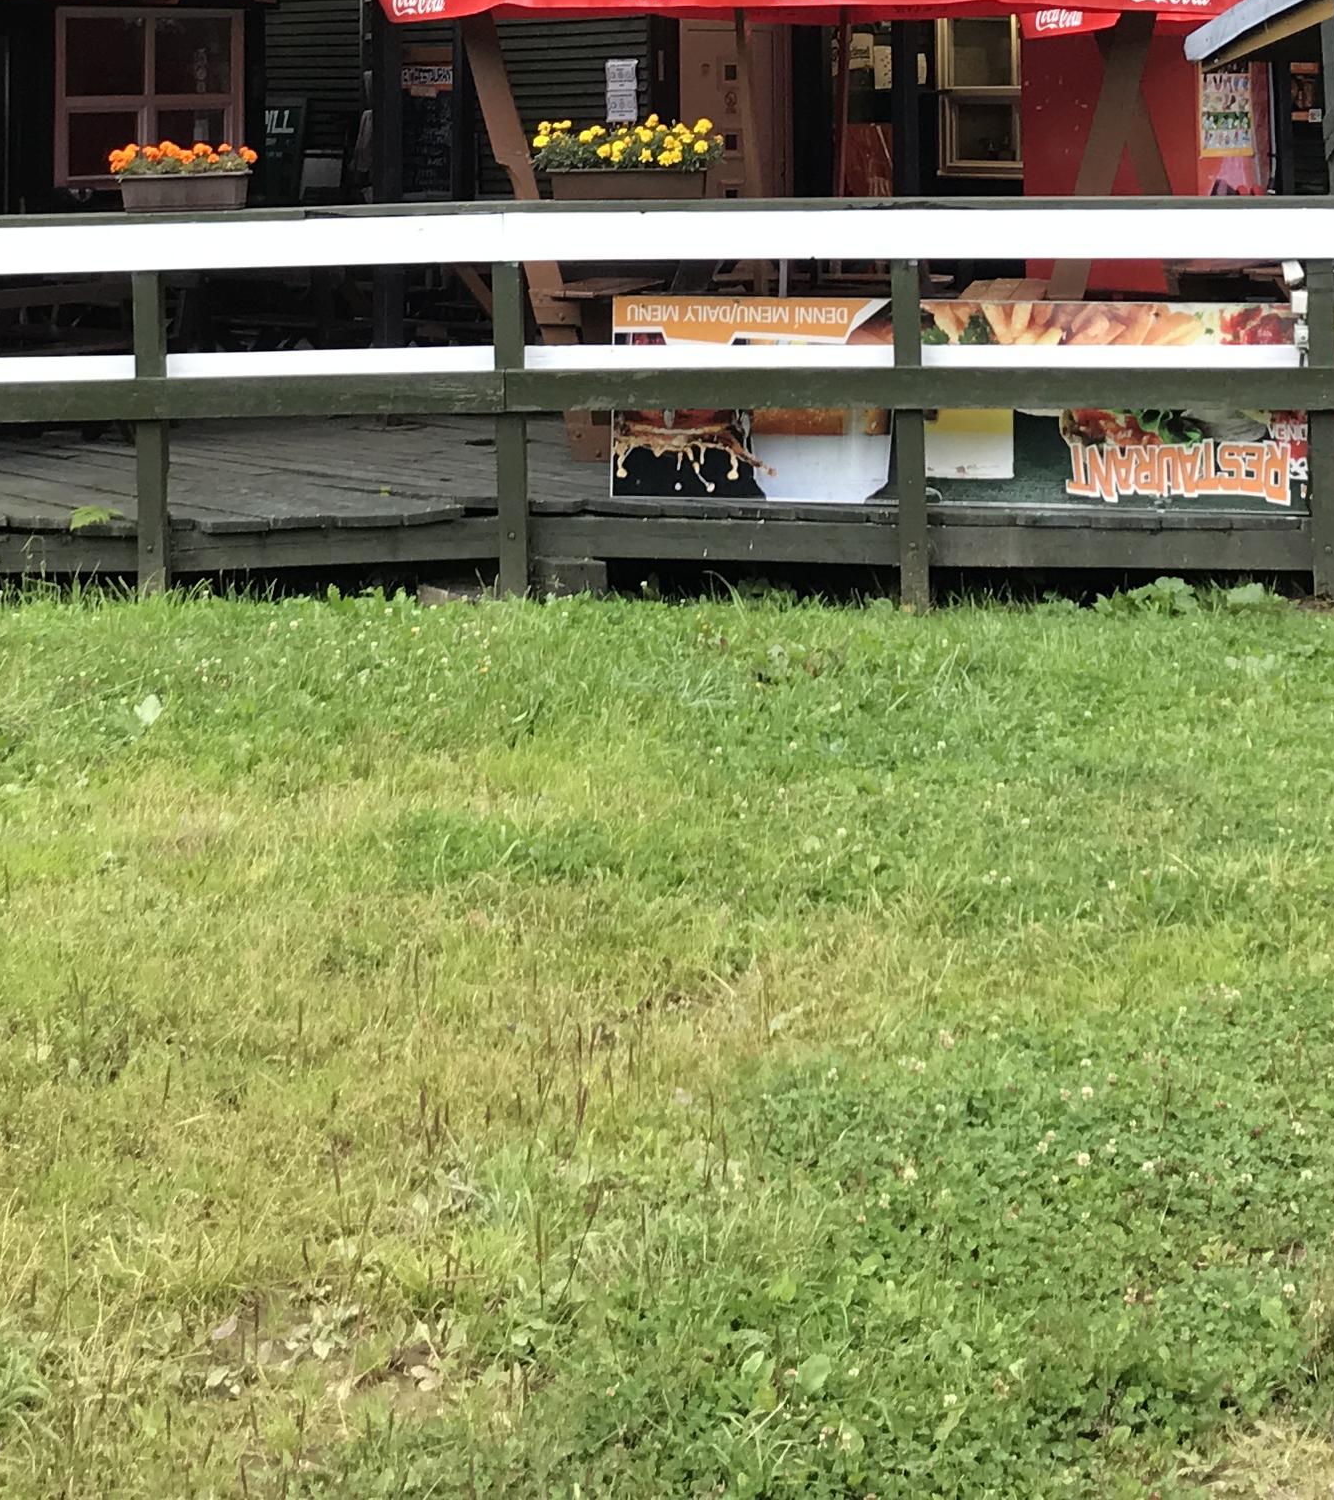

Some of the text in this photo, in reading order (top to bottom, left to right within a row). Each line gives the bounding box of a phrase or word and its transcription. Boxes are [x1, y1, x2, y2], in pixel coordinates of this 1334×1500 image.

[626, 303, 849, 329] DENNÍ MENU/DAILY MENU
[1067, 438, 1292, 505] RESTAURANT
